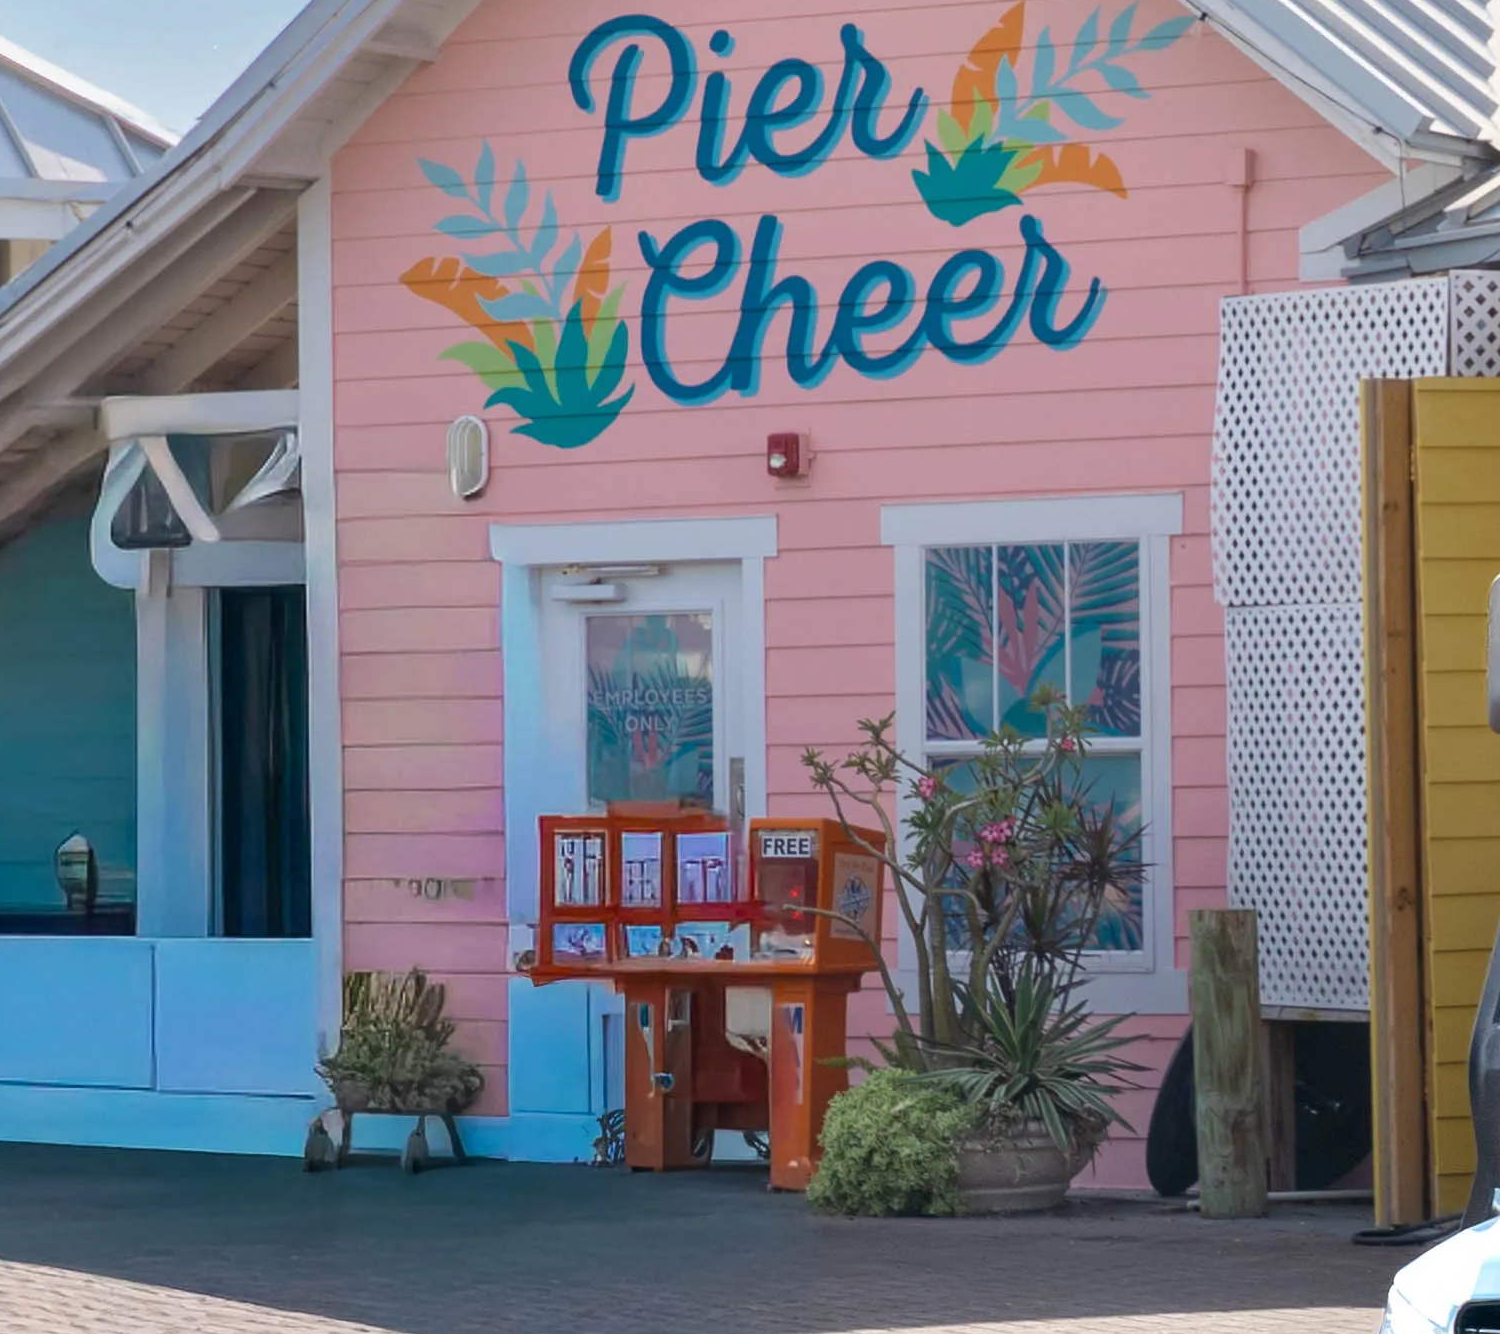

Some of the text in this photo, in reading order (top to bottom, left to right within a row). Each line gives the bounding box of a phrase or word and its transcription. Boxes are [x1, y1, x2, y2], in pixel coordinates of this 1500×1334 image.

[568, 13, 928, 202] Pier
[637, 213, 1107, 405] Cheer
[593, 688, 707, 705] EMPLOYEES
[625, 716, 673, 732] ONLY
[763, 838, 810, 855] FREE
